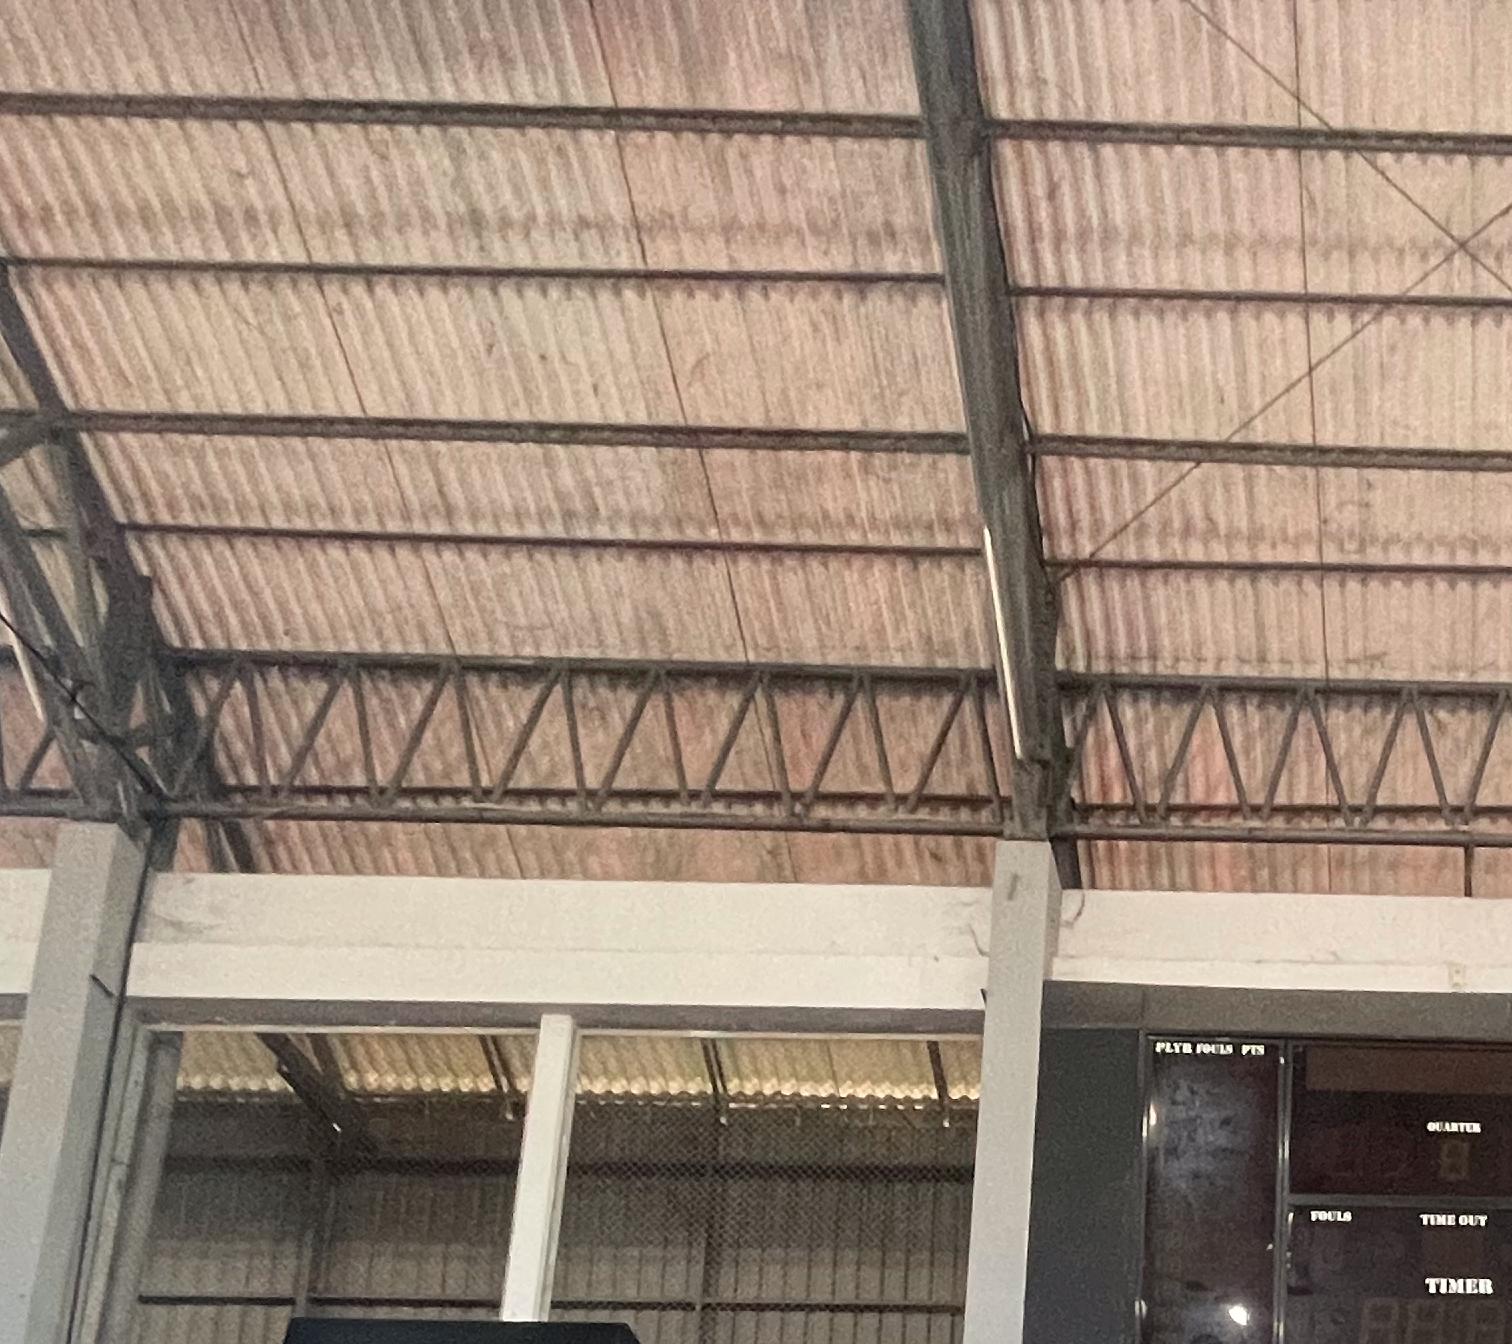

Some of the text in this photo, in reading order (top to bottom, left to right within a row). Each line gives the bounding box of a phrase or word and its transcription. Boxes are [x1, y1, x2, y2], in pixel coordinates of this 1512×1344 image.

[1427, 1121, 1481, 1133] QUARTER
[1310, 1210, 1352, 1222] FOULS
[1419, 1214, 1488, 1226] TIME OUT
[1424, 1278, 1493, 1294] TIMER
